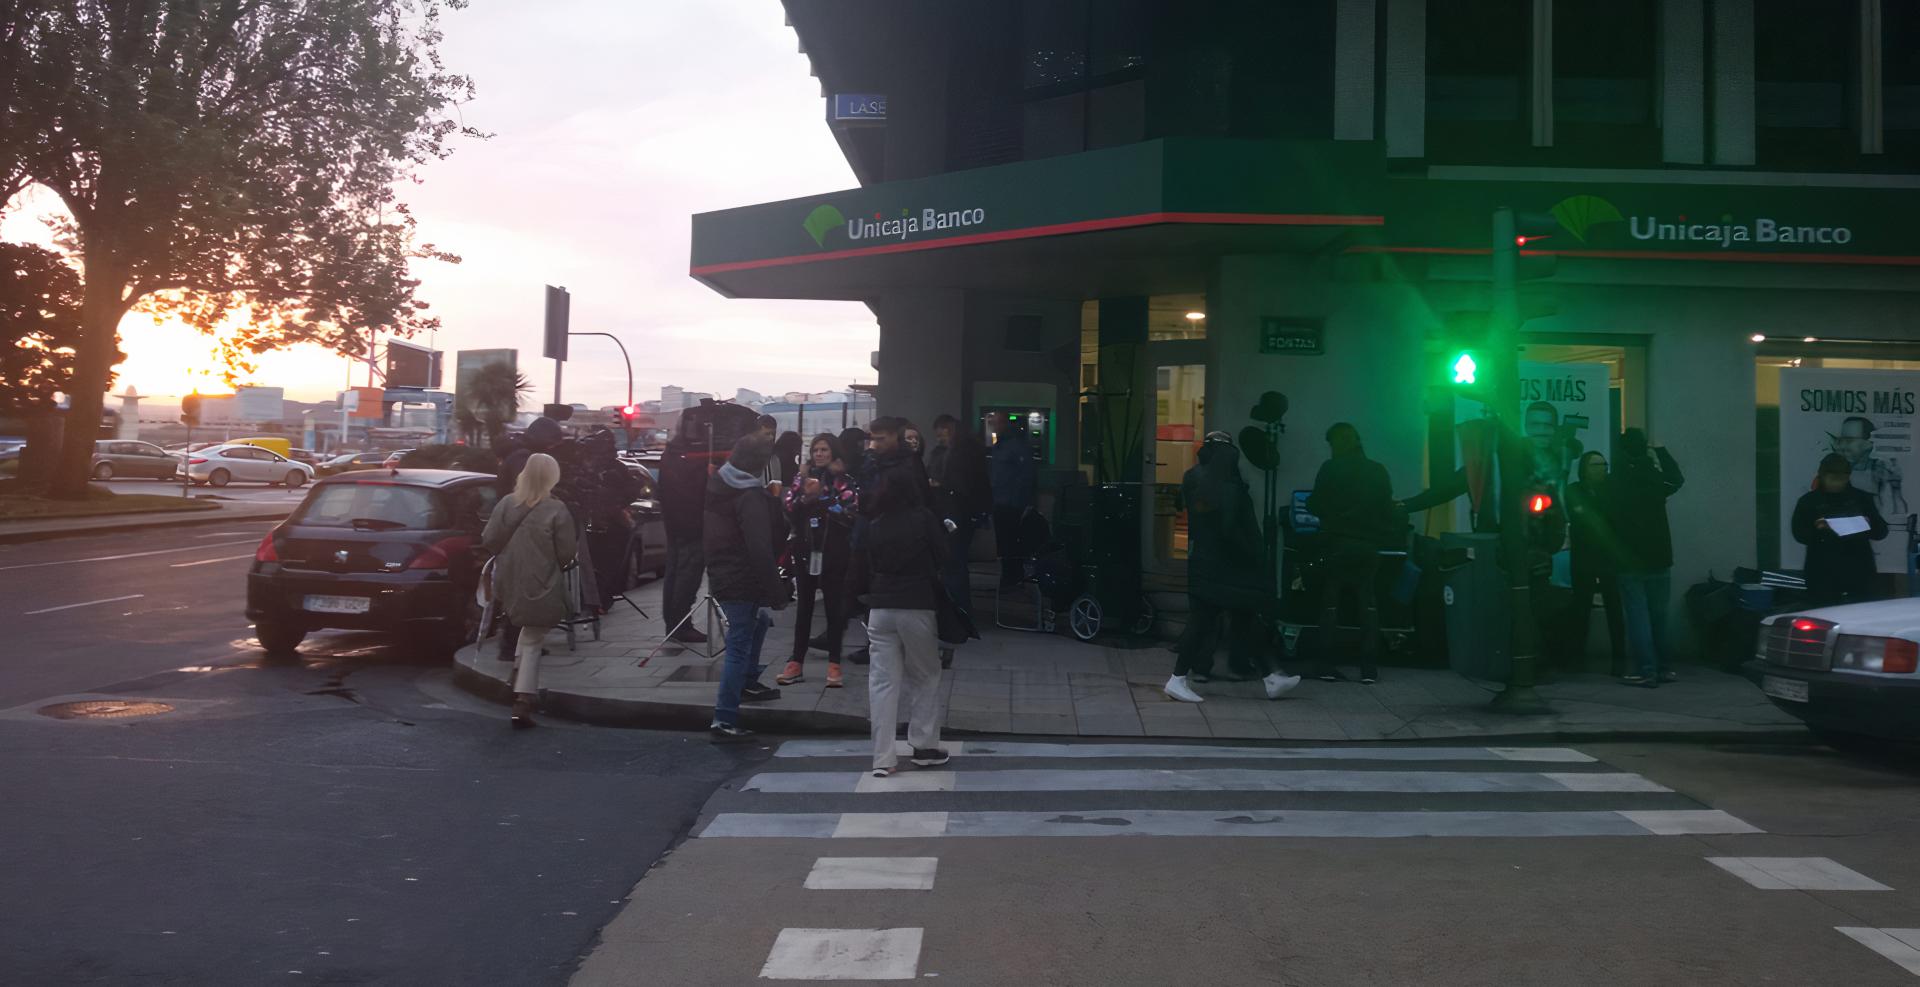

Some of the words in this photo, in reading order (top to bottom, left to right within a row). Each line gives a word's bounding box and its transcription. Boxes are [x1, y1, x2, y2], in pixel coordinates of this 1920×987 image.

[848, 208, 919, 240] Unicaja
[922, 207, 985, 232] Banco
[1630, 214, 1751, 248] Unicaja
[1756, 218, 1851, 244] Banco
[1546, 374, 1586, 402] MÁS
[1801, 388, 1867, 413] SOMOS
[1873, 387, 1915, 415] MÁS
